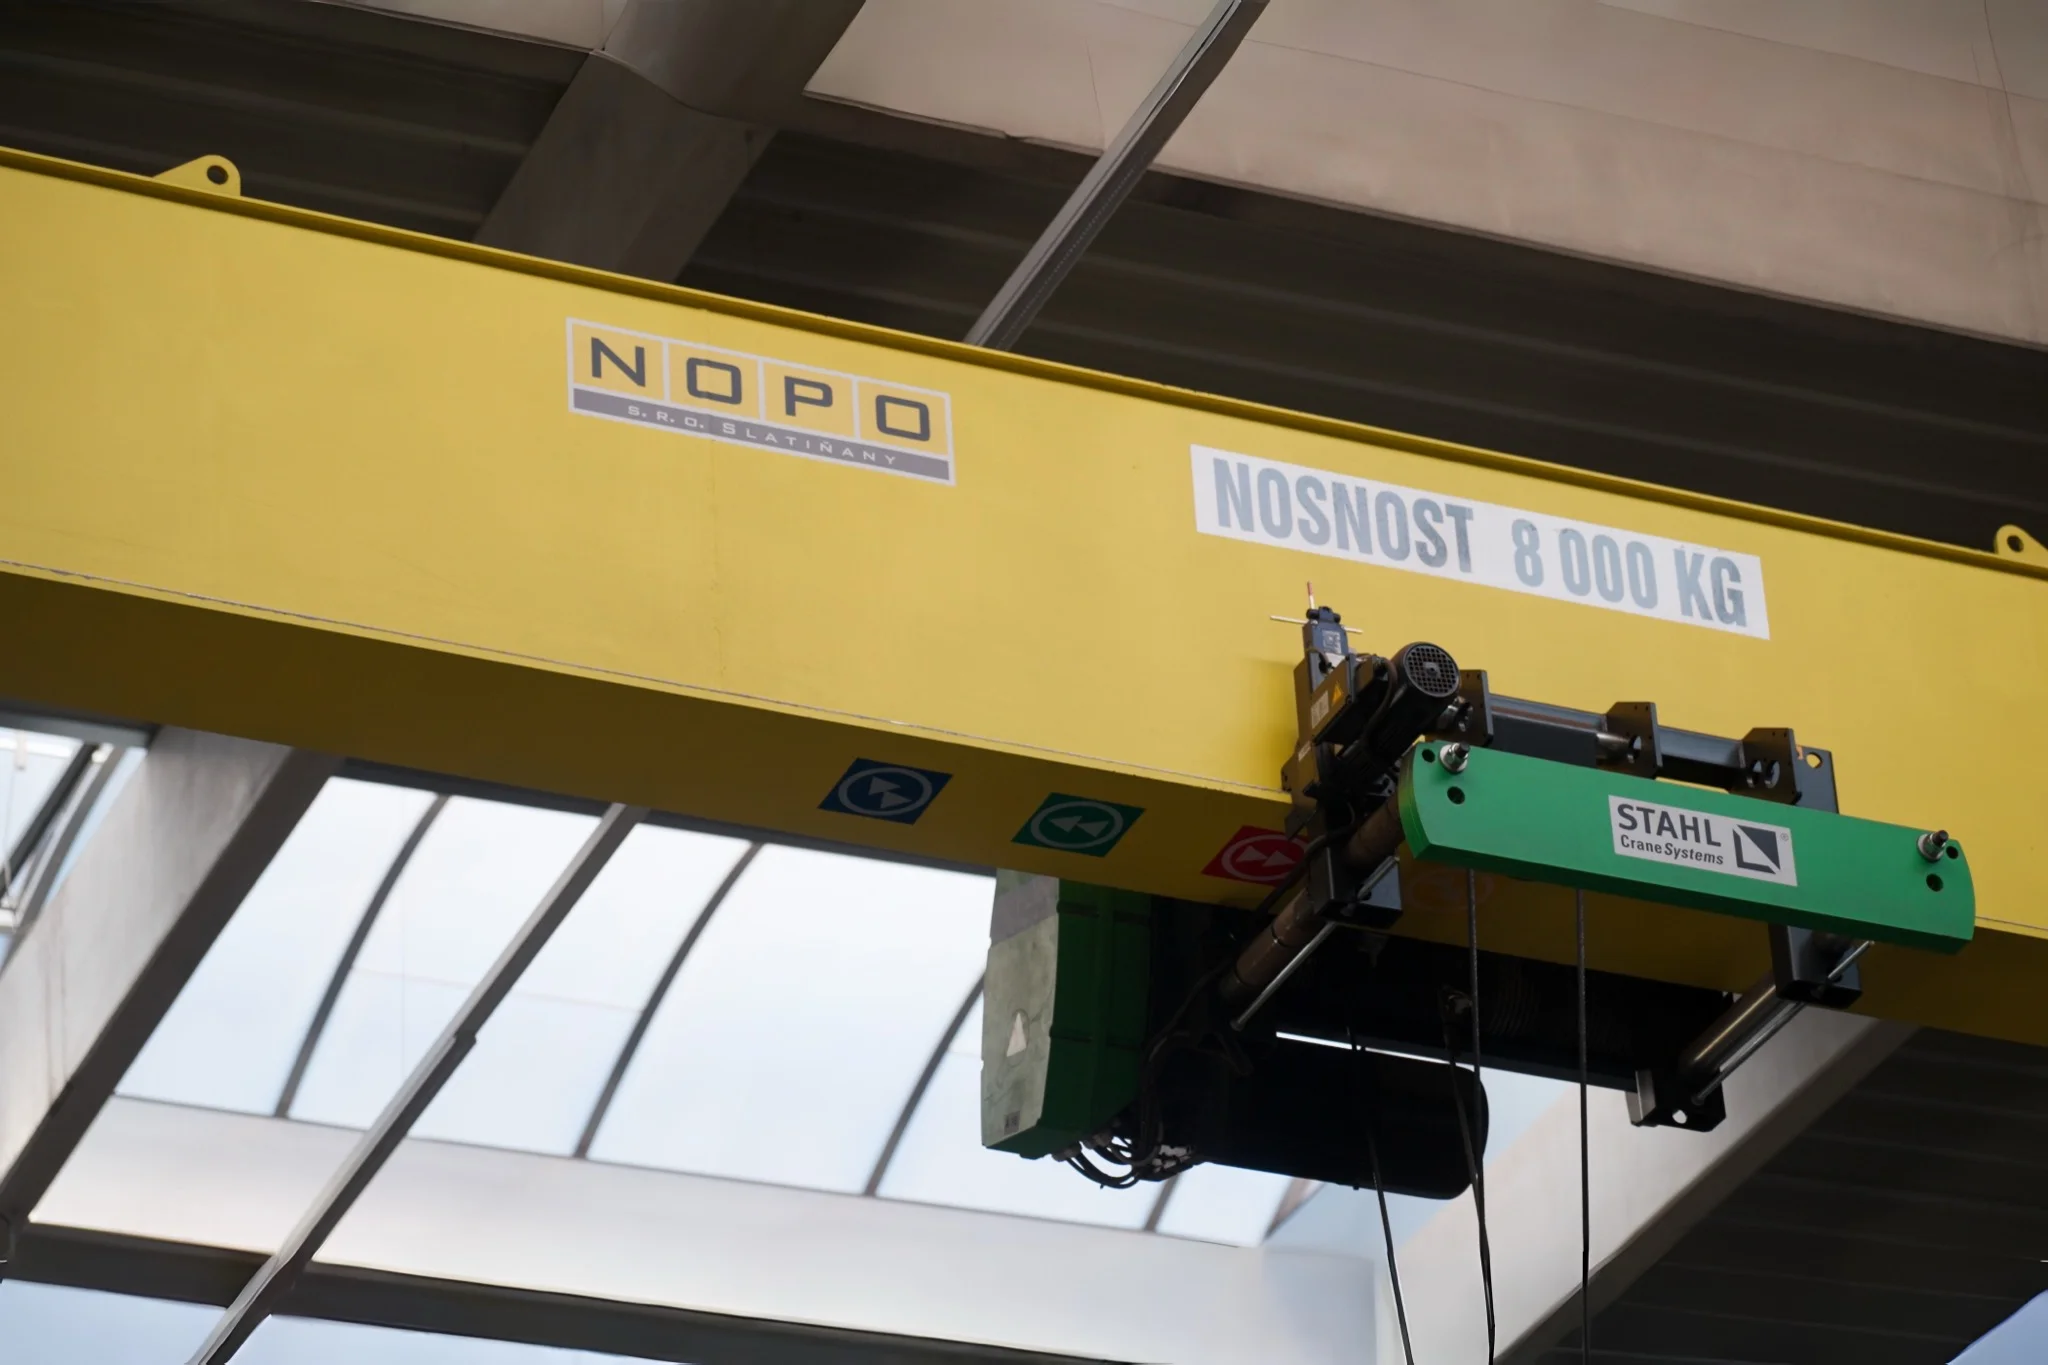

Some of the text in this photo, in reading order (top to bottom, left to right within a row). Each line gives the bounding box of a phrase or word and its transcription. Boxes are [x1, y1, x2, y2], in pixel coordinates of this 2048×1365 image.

[590, 336, 931, 442] NOPO
[1212, 457, 1474, 573] NOSNOST
[1675, 547, 1748, 628] KG
[1617, 803, 1722, 847] STAHL
